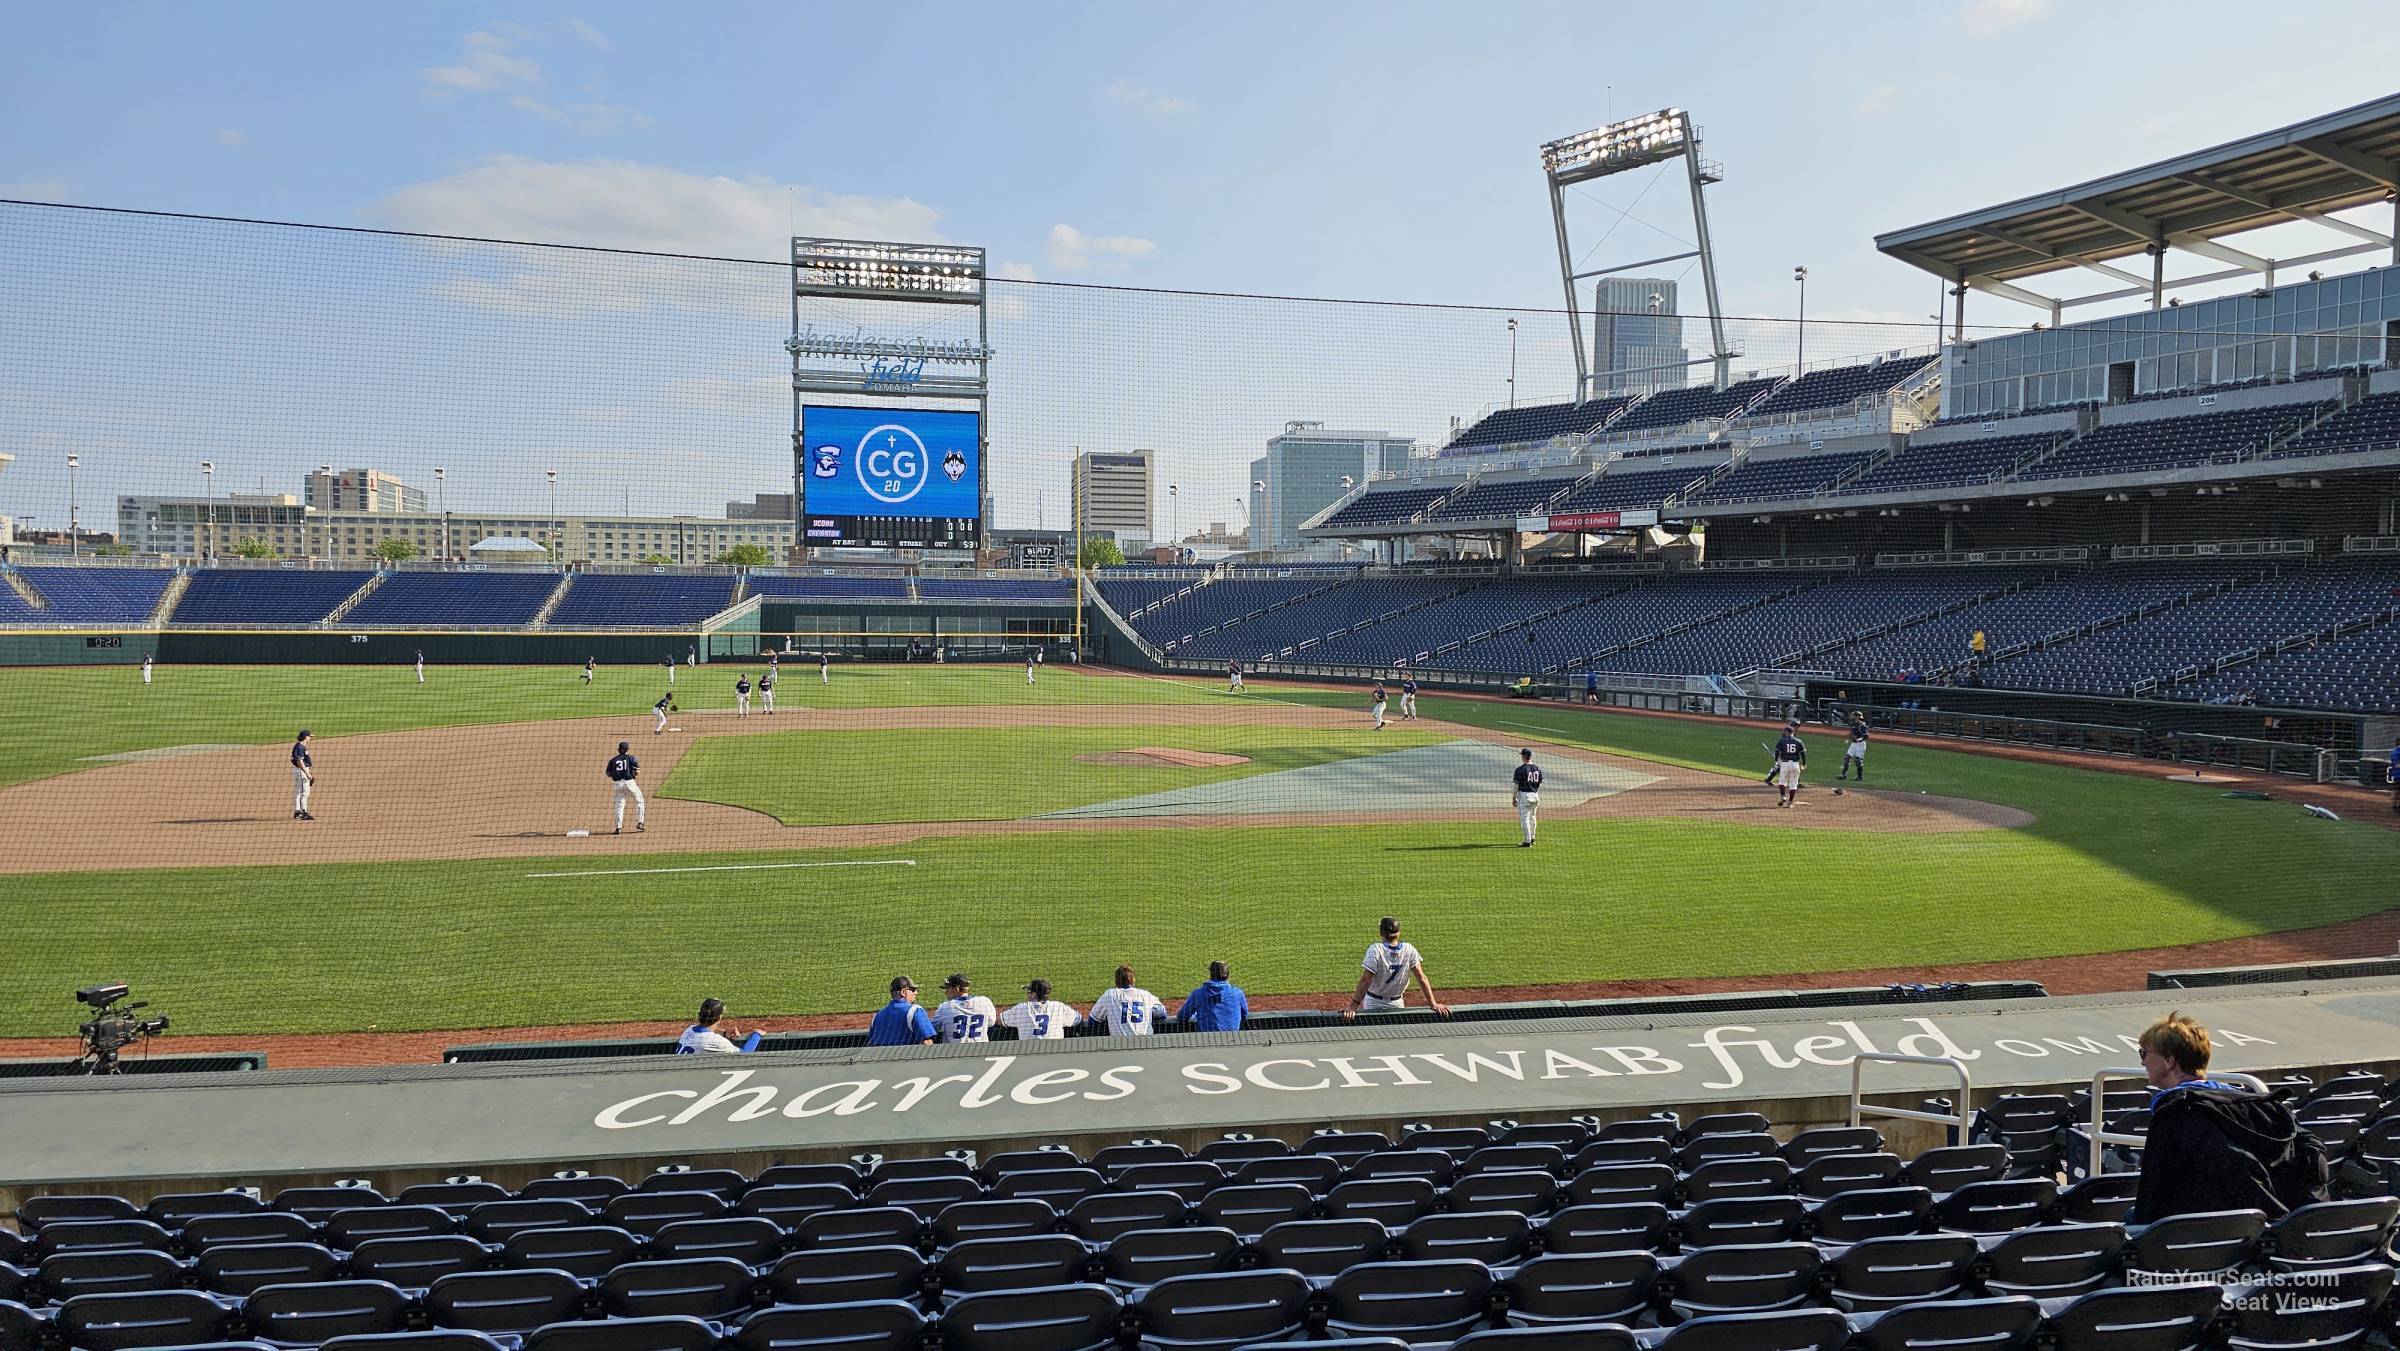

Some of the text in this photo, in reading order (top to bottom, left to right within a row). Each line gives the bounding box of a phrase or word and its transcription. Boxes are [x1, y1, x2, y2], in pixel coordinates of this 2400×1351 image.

[864, 357, 925, 389] field
[868, 450, 916, 477] CG
[884, 480, 900, 492] 20
[948, 522, 953, 531] 0
[960, 522, 965, 531] 0
[948, 531, 953, 540] 0
[351, 635, 368, 643] 375
[1786, 743, 1796, 753] 16
[616, 760, 627, 771] 31
[1386, 965, 1403, 984] 7
[1120, 1001, 1145, 1025] 15
[952, 1014, 985, 1040] 32
[1033, 1014, 1050, 1036] 3
[594, 1056, 1144, 1129] charles
[1182, 1046, 1684, 1095] SCHWAB
[1687, 1017, 1981, 1090] field
